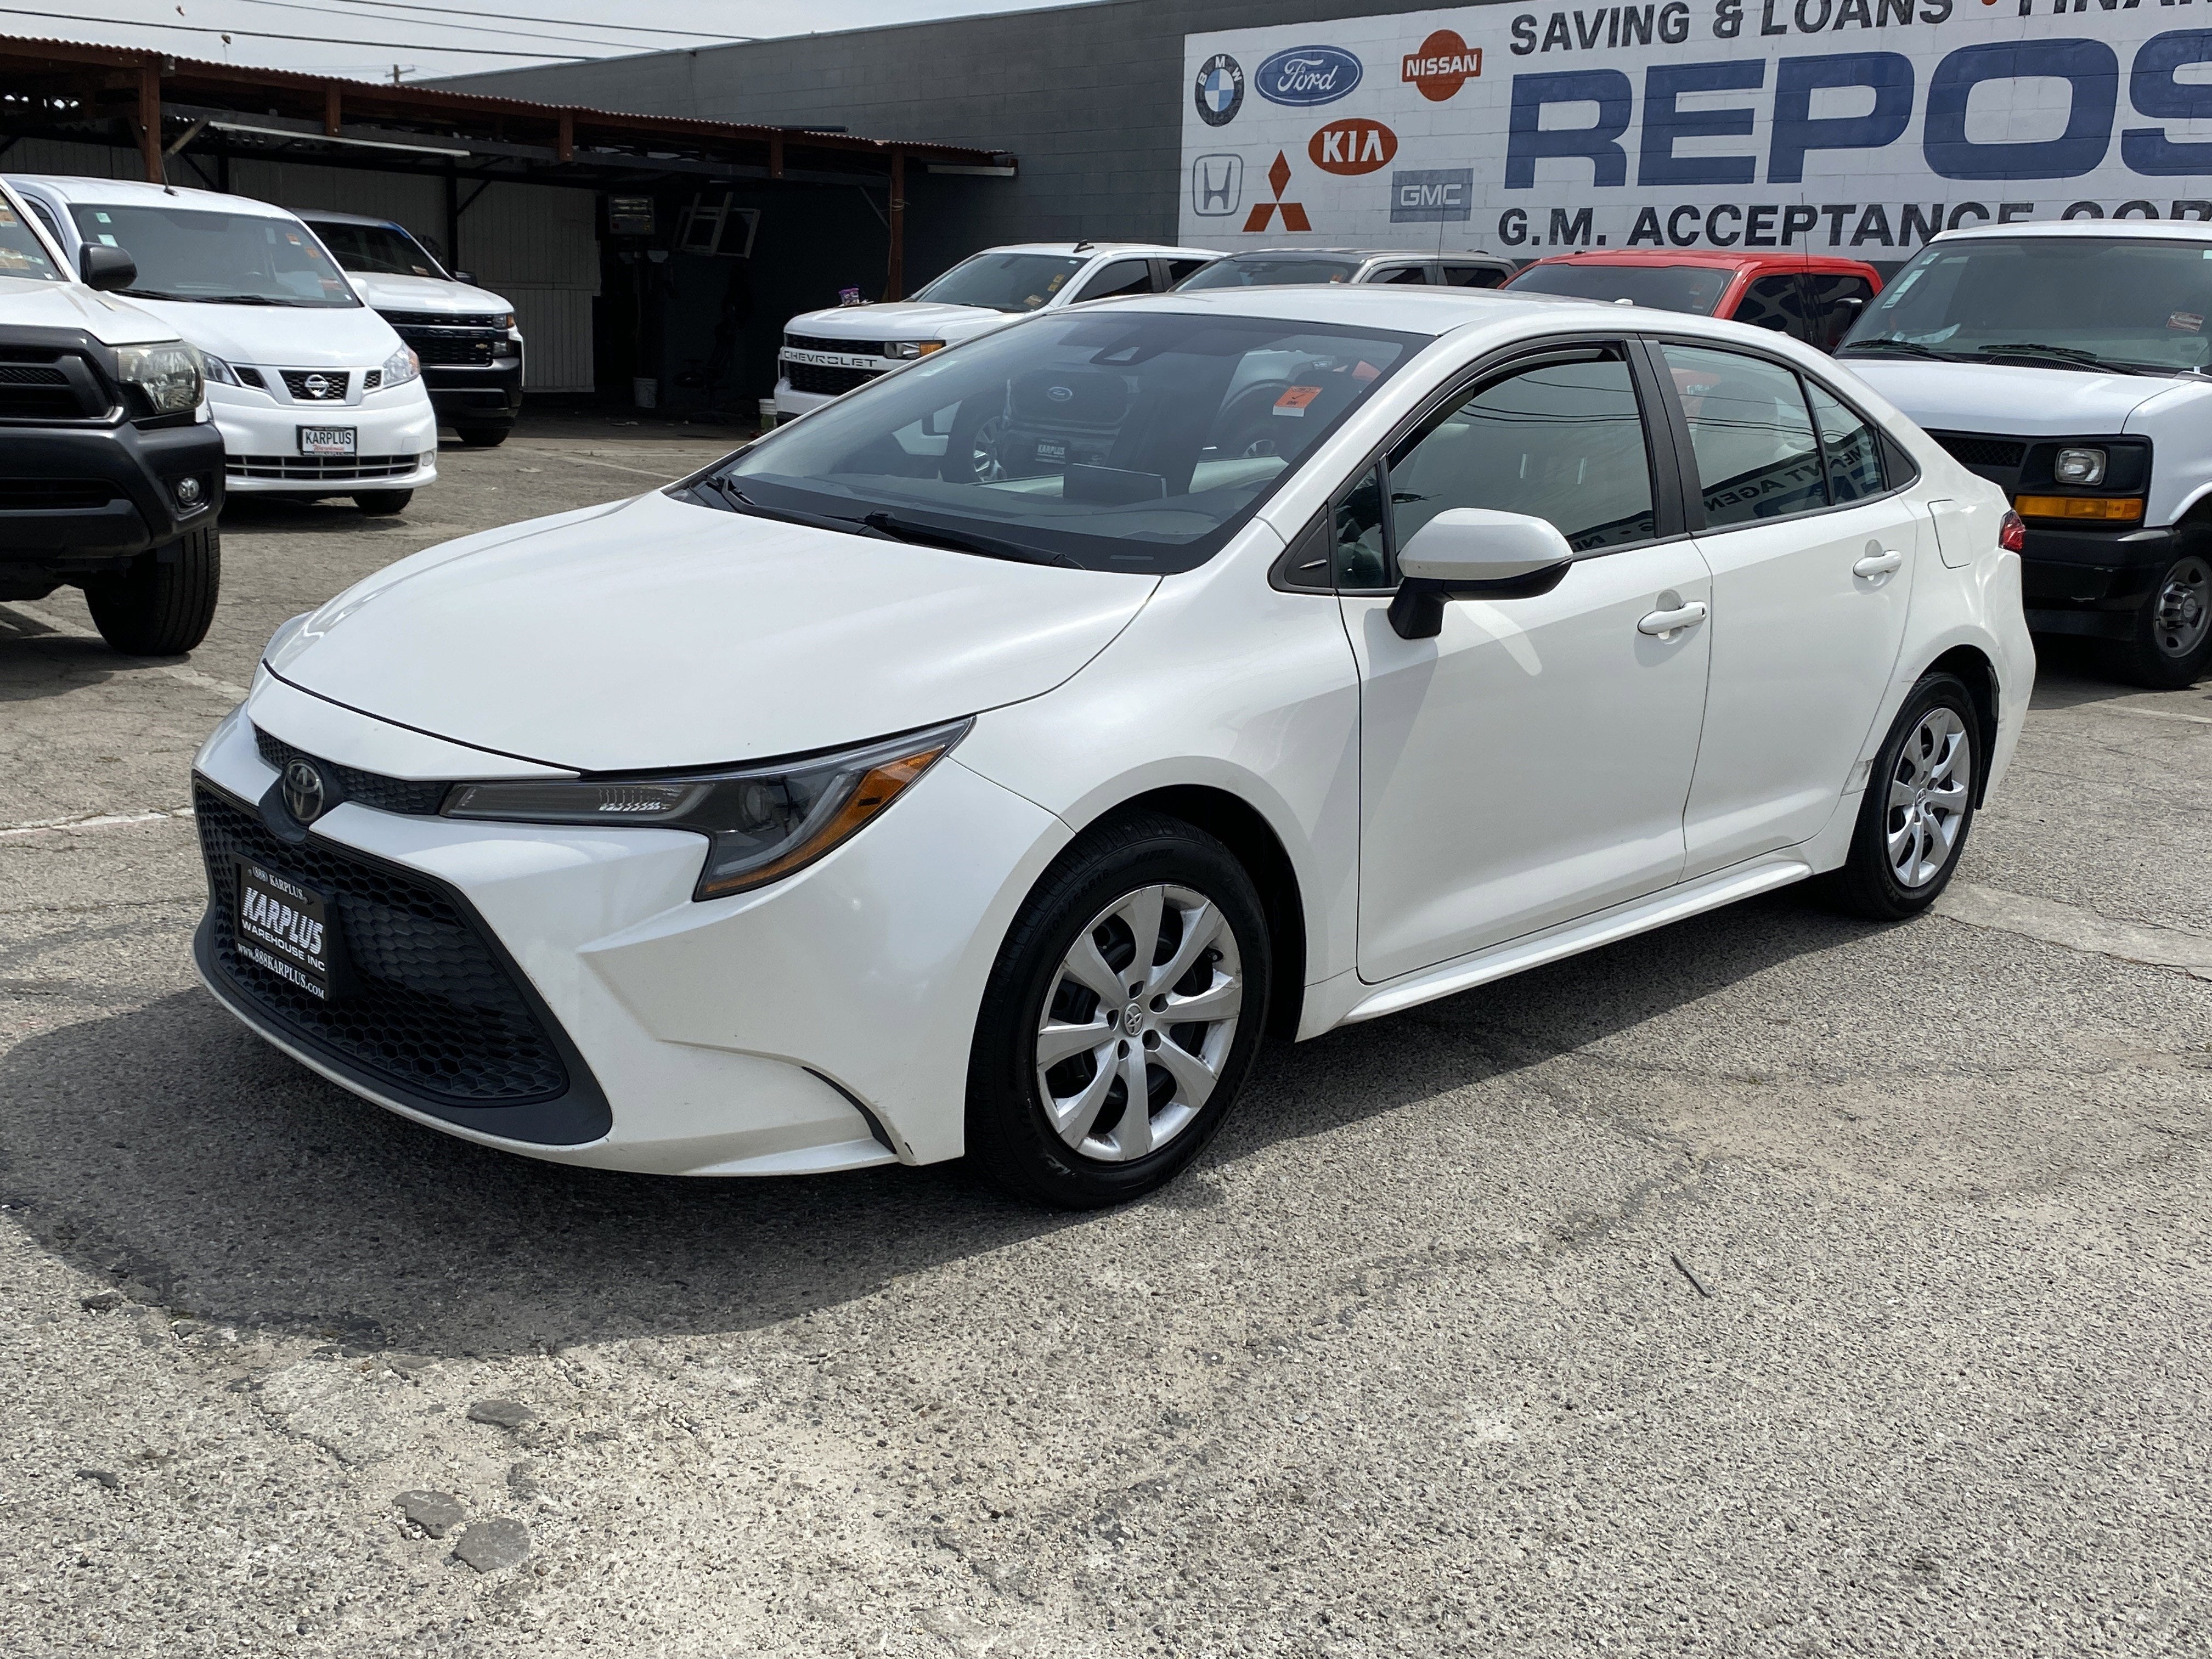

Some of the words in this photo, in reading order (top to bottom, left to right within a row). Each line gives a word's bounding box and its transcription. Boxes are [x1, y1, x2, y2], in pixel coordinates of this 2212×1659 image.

[1510, 2, 1689, 55] SAVING
[1712, 0, 1743, 38] &
[1198, 56, 1242, 86] BMW
[1278, 59, 1339, 92] Ford
[1406, 54, 1477, 76] NISSAN
[1322, 129, 1384, 162] KIA
[1401, 184, 1462, 206] GMC
[1498, 207, 1606, 246] G.M.
[784, 351, 877, 368] CHEVROLET
[305, 431, 352, 444] KARPLUS
[269, 874, 304, 900] KARPLUS
[242, 887, 323, 954] KARPLUS
[242, 918, 305, 960] WAREHOUSE
[307, 954, 325, 971] INC
